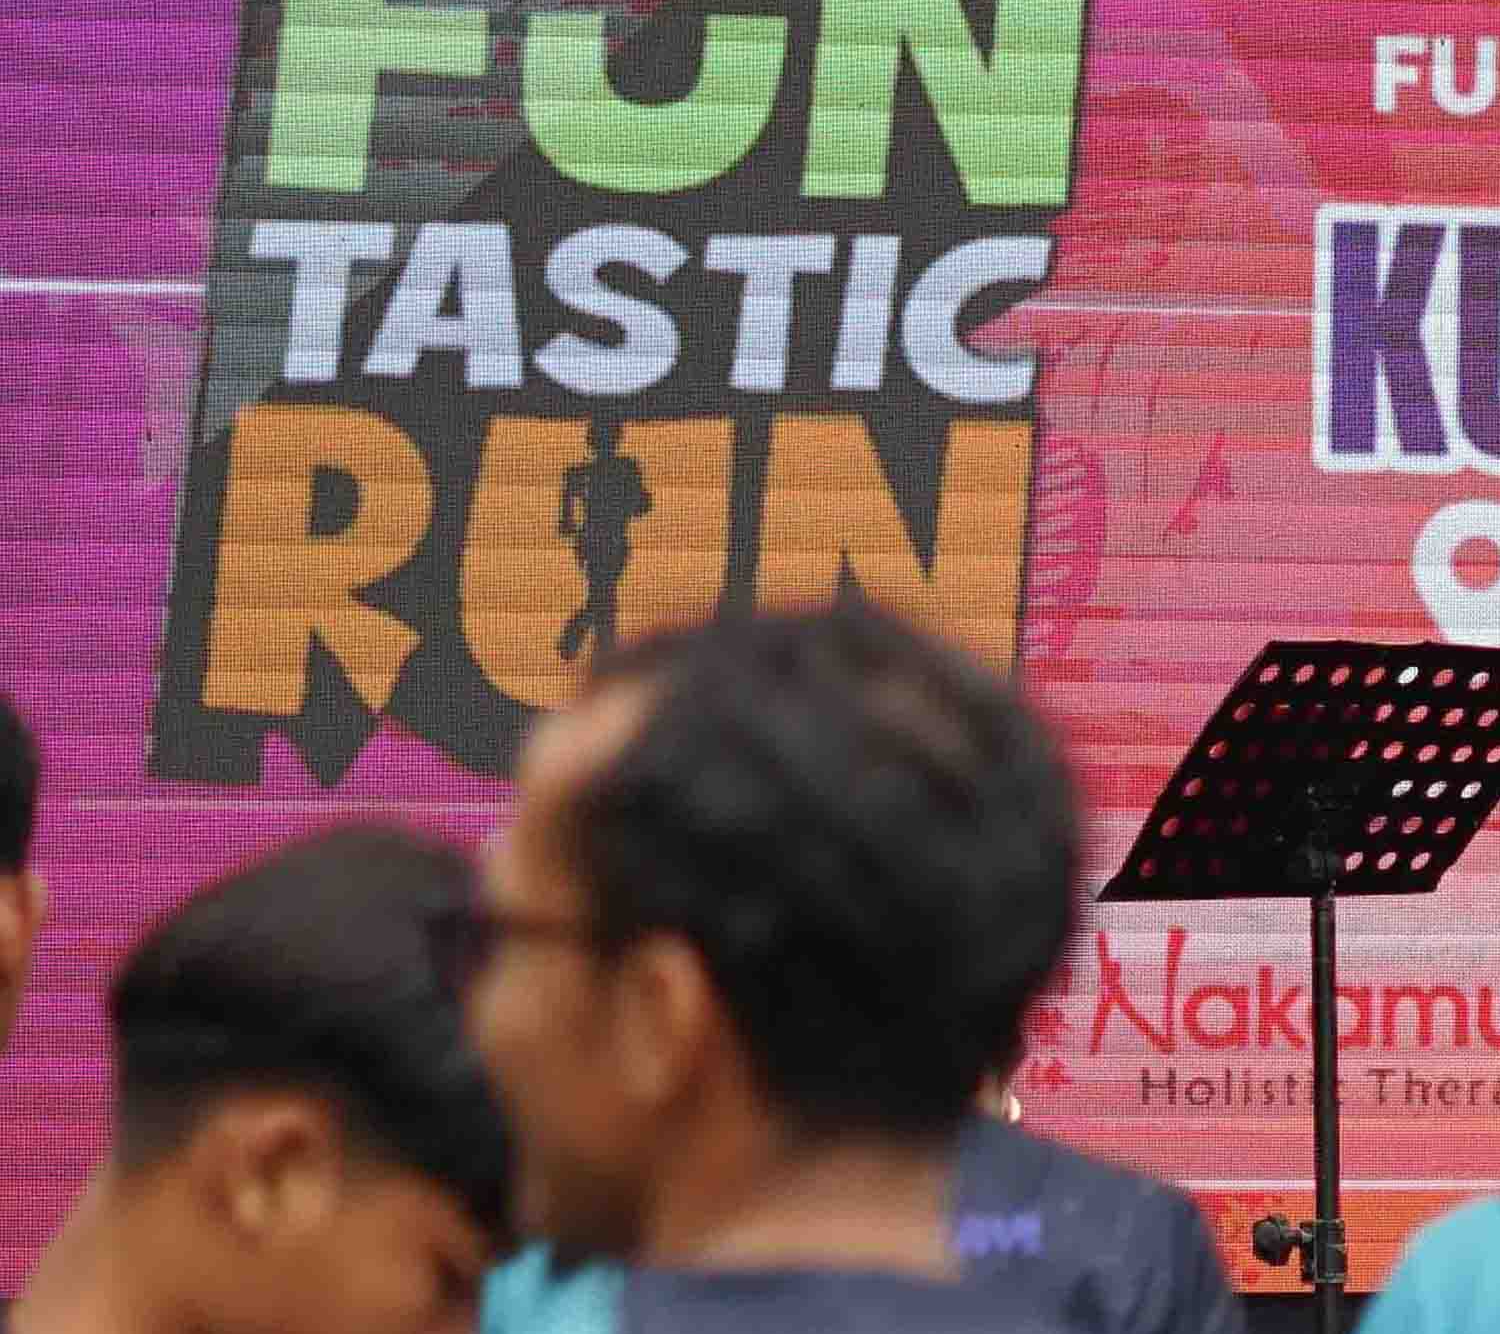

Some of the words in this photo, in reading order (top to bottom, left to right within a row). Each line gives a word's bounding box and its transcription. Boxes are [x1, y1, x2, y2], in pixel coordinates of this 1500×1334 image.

[248, 219, 1056, 406] TASTIC
[200, 401, 1036, 714] RUN
[1140, 1067, 1342, 1107] Holist
